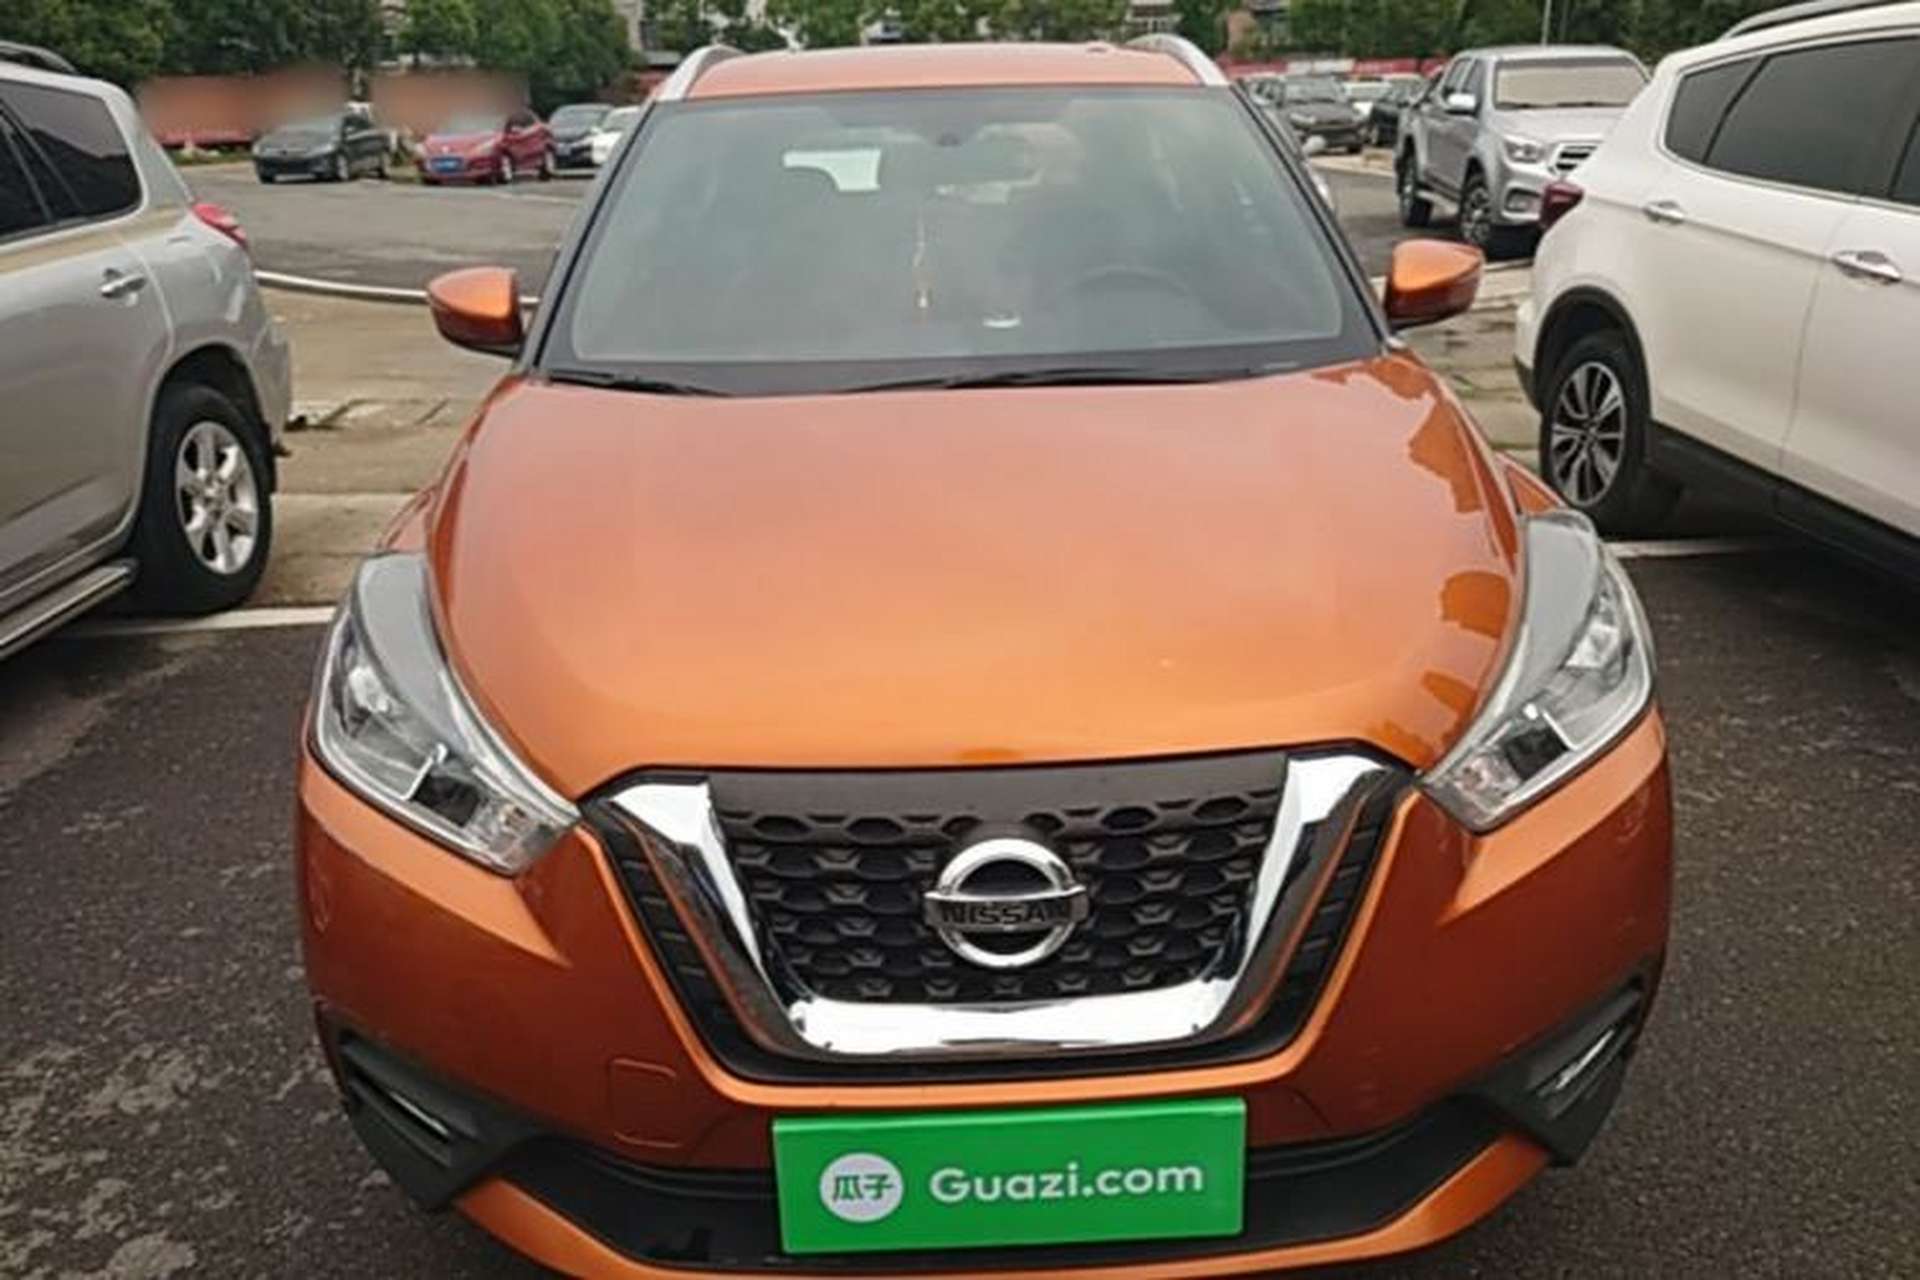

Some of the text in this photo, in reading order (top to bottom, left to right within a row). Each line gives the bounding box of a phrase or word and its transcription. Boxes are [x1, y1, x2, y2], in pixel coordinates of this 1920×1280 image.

[940, 900, 1072, 925] NISSAN
[832, 1173, 895, 1202] 瓜子
[929, 1161, 1203, 1202] Guazi.com
